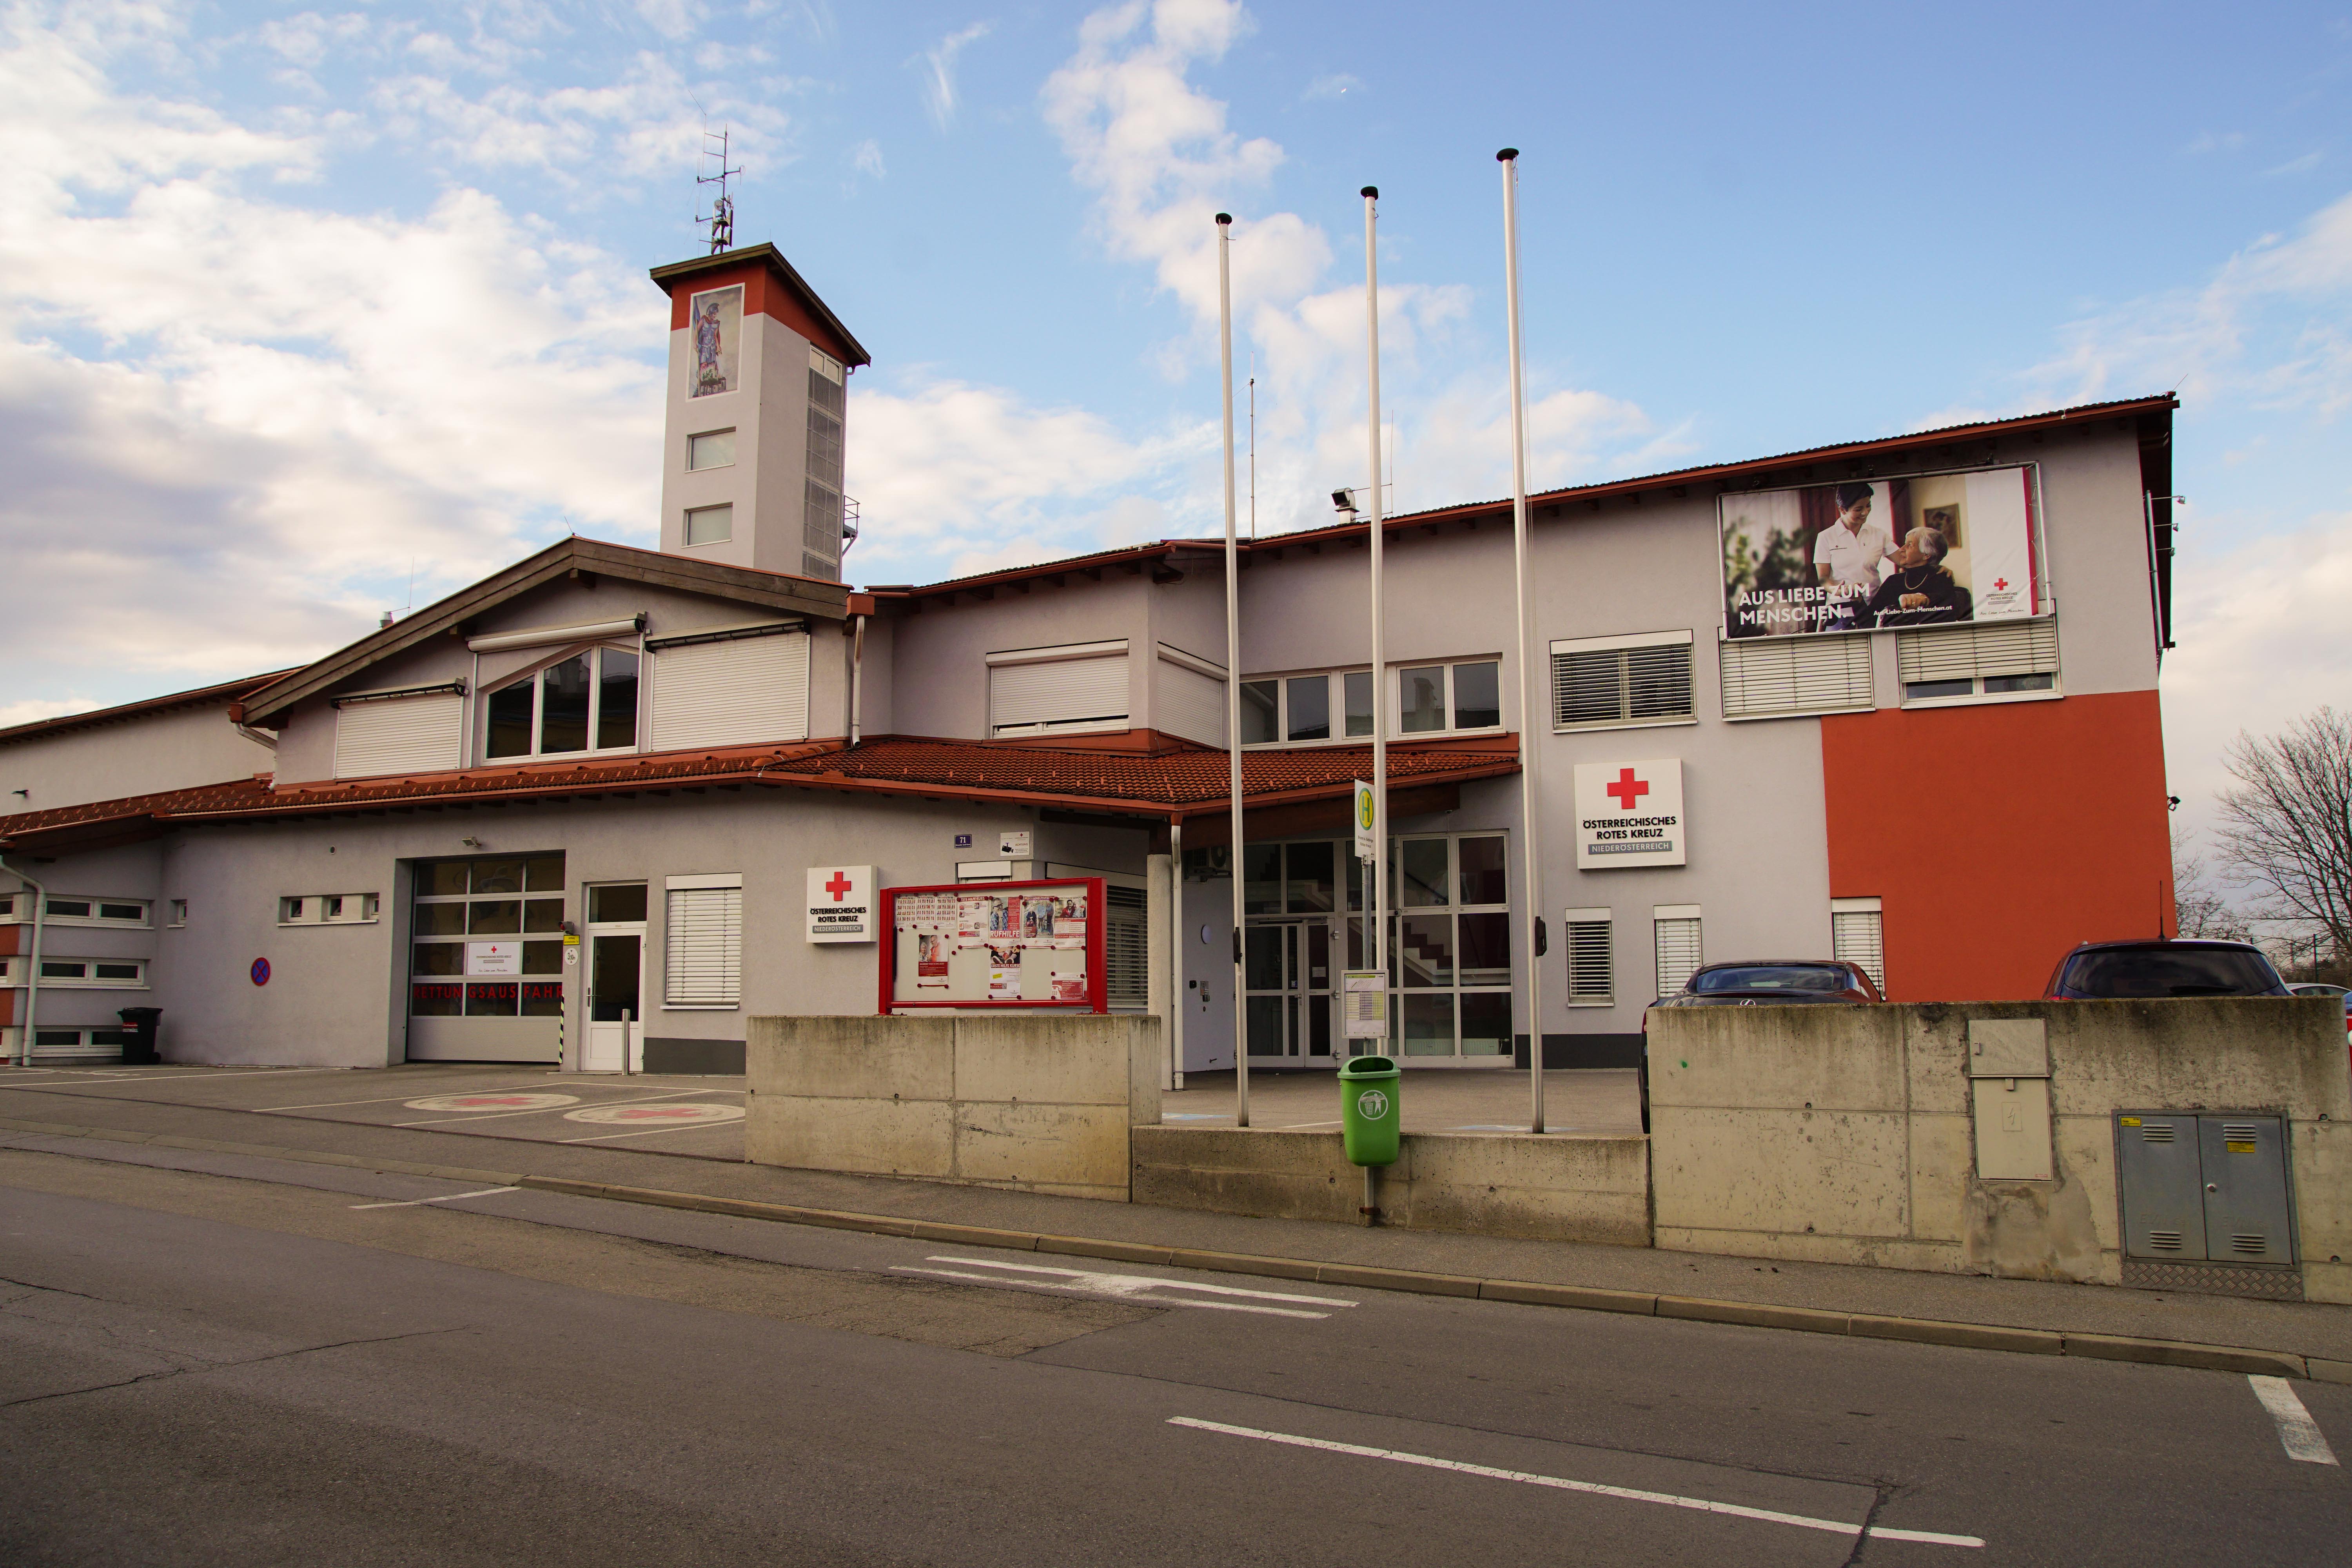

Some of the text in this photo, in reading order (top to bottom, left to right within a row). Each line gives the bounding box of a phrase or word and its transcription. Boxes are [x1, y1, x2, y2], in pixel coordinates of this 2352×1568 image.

[1739, 583, 1870, 606] AUS LIEBE ZUM
[1740, 604, 1847, 625] MENSCHEN.
[1873, 605, 1953, 616] Aus-Liebe-Zum-Menschen.at
[1362, 796, 1370, 822] H
[1583, 816, 1676, 829] ÖSTERREICHISCHES
[1597, 828, 1663, 840] ROTES KREUZ
[1592, 842, 1669, 853] NIEDERÖSTERREICH
[413, 985, 562, 999] RETTUNGSAUSFAHR
